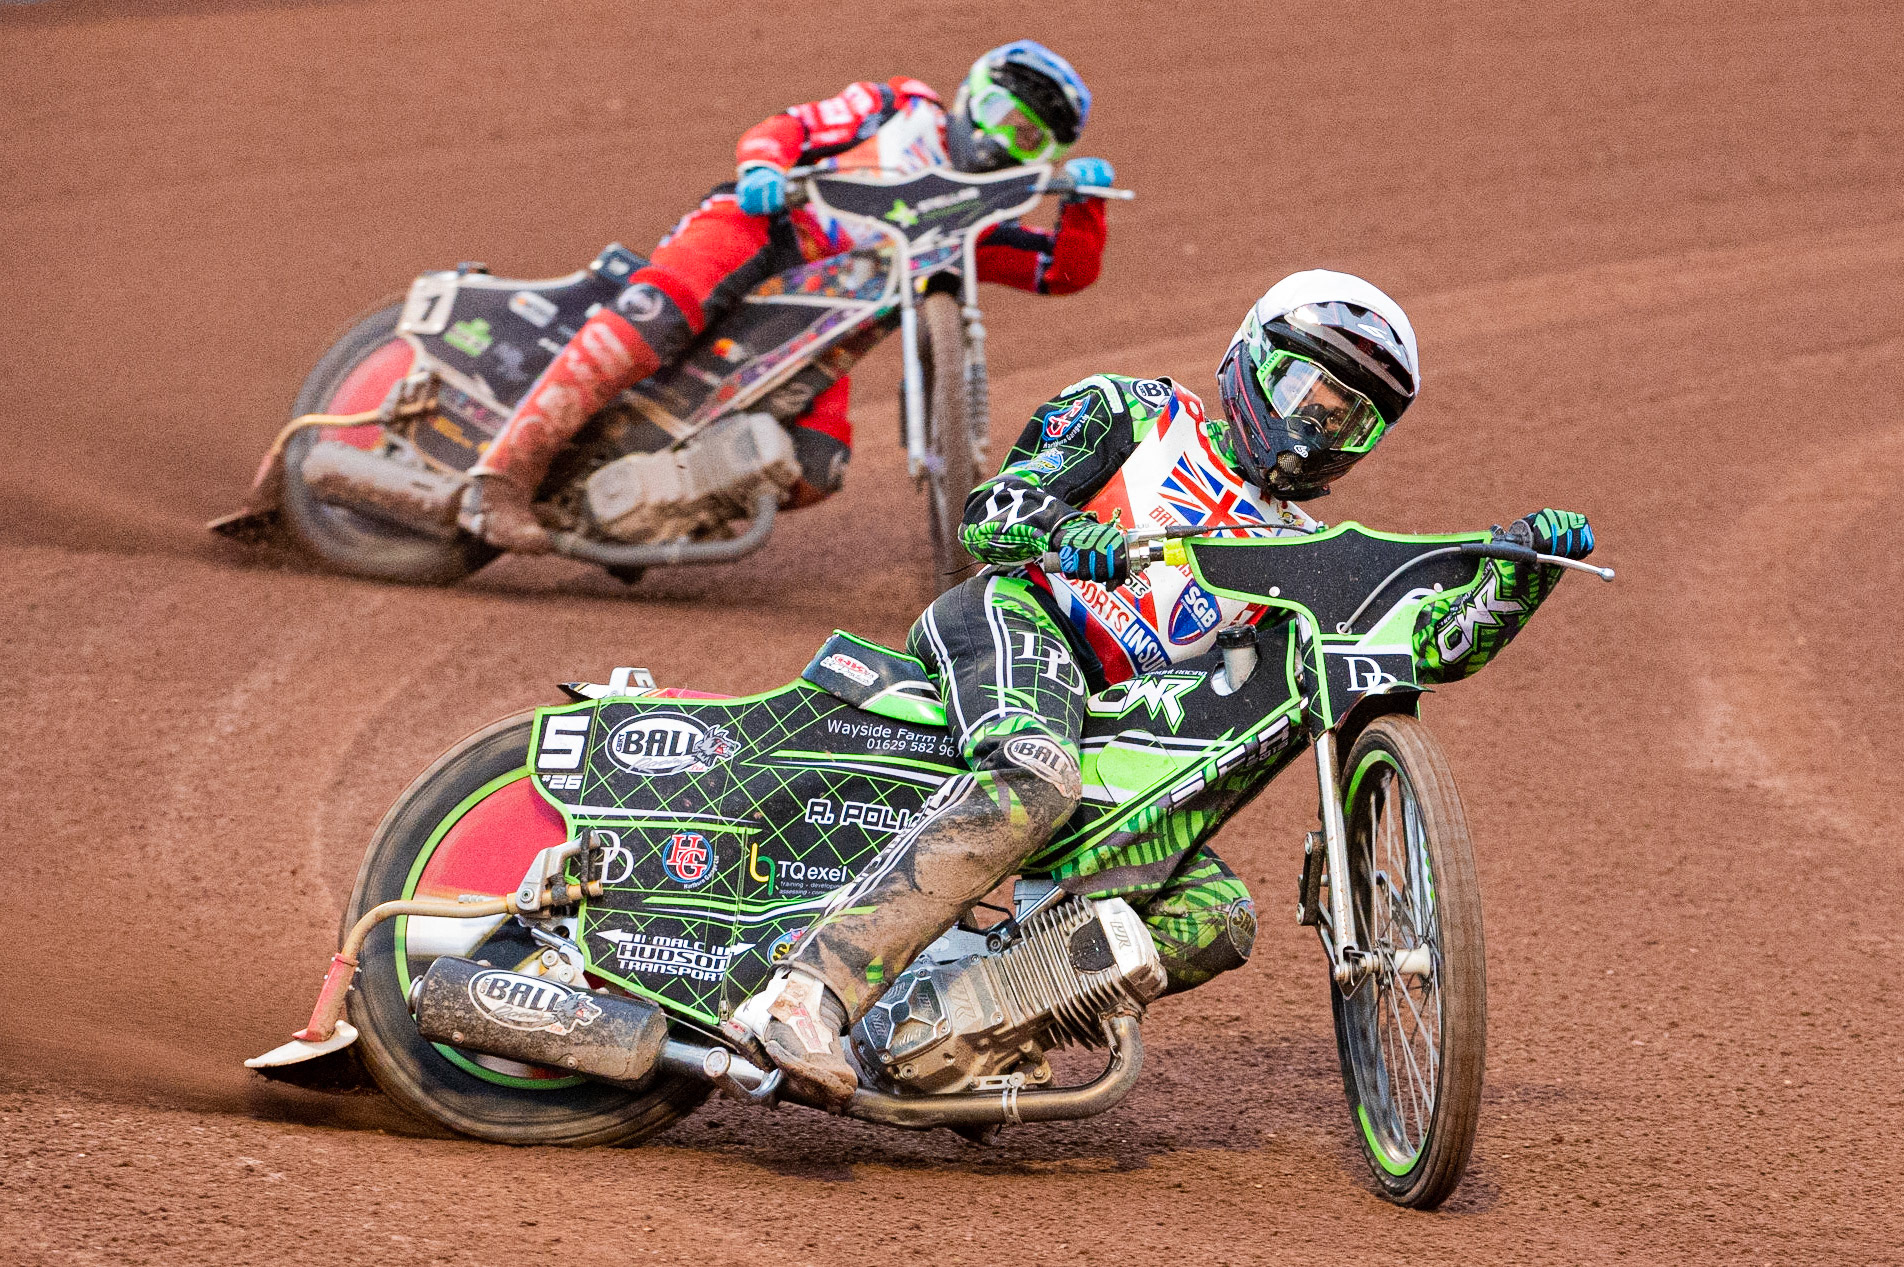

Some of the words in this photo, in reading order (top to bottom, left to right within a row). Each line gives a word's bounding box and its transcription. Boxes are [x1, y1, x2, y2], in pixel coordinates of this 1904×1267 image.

[1124, 577, 1145, 597] OLS
[1184, 586, 1218, 628] SGB
[537, 715, 591, 769] 5
[827, 719, 892, 738] Wayside
[897, 728, 936, 743] Farm
[621, 730, 698, 756] BALL
[866, 738, 906, 750] 01629
[910, 741, 935, 753] 582
[542, 775, 583, 790] #26
[652, 936, 705, 952] MALC
[617, 959, 725, 981] TRANSPORT
[486, 977, 561, 1013] BALL
